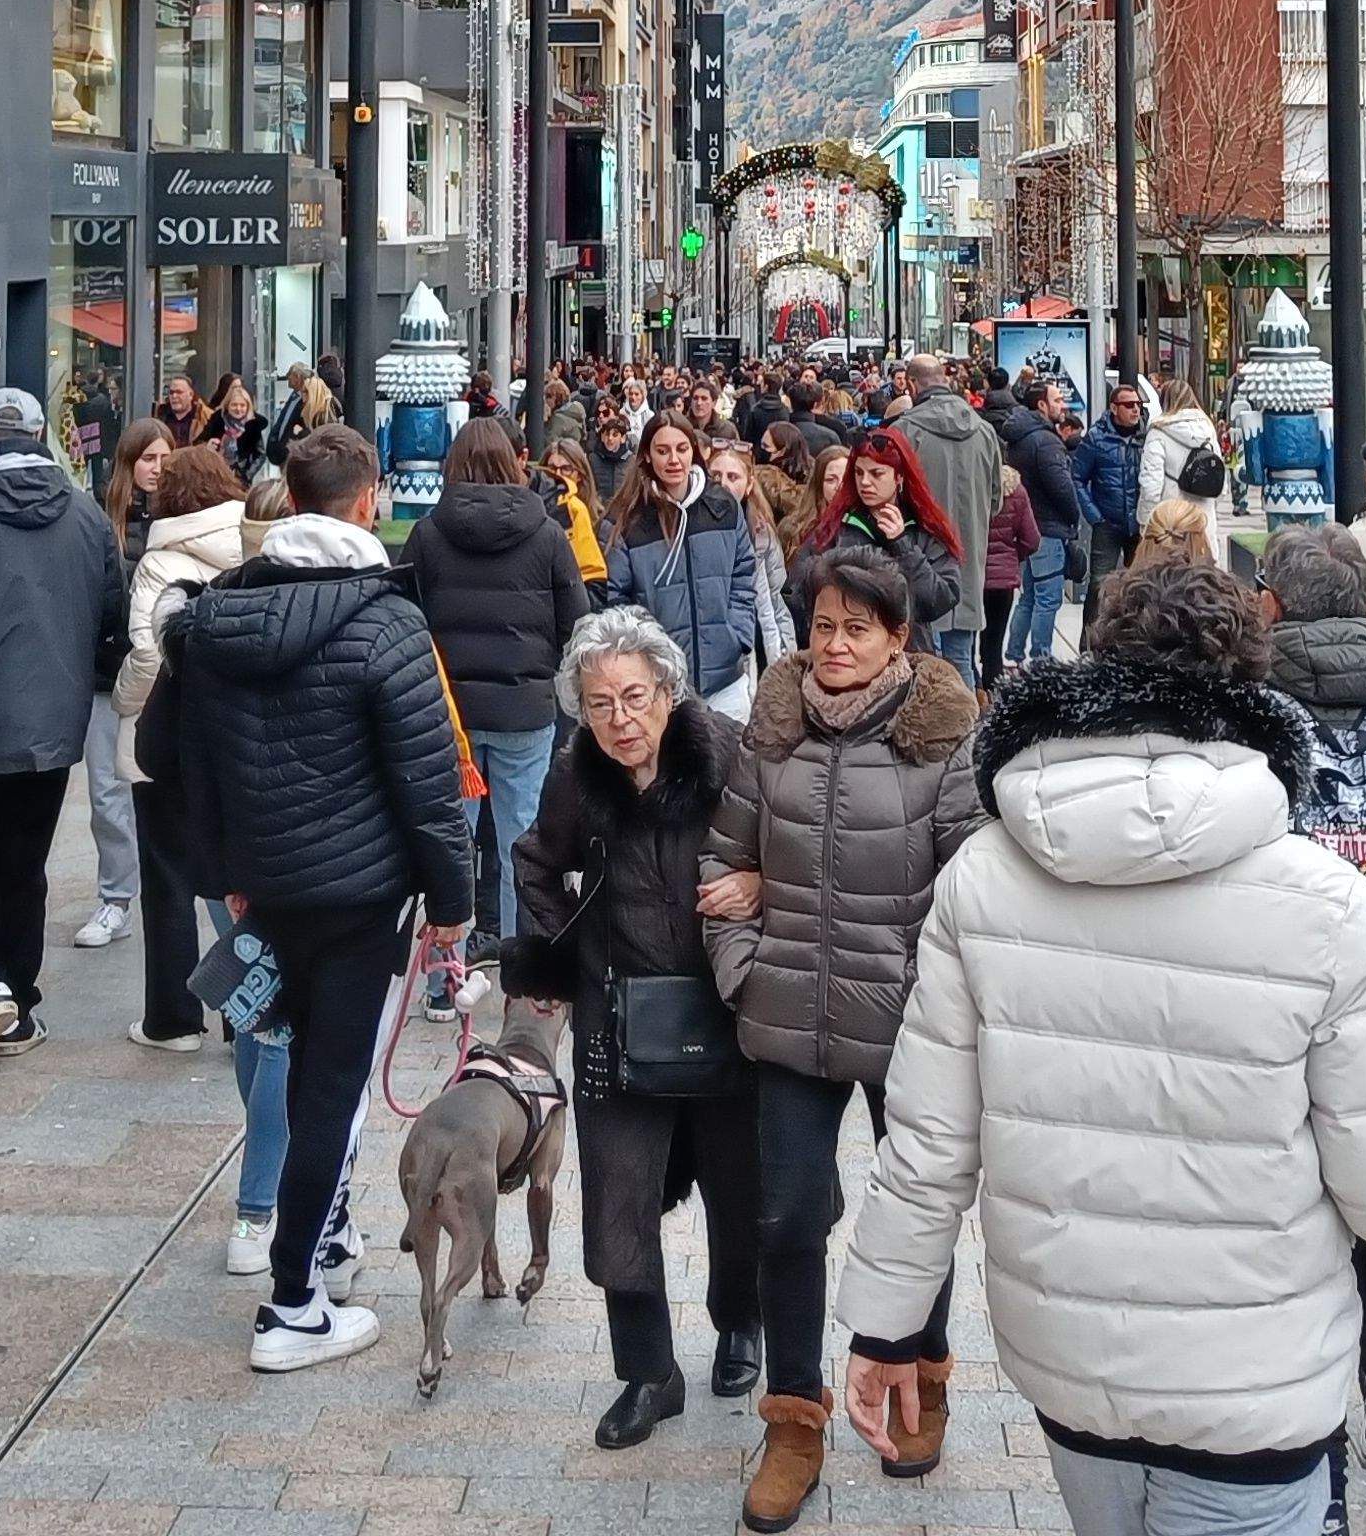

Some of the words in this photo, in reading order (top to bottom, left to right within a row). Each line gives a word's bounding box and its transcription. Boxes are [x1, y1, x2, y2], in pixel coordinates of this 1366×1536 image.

[73, 162, 120, 187] POLLYANNA
[708, 133, 720, 189] HOTE
[166, 168, 275, 195] llenceria
[157, 216, 282, 246] SOLER
